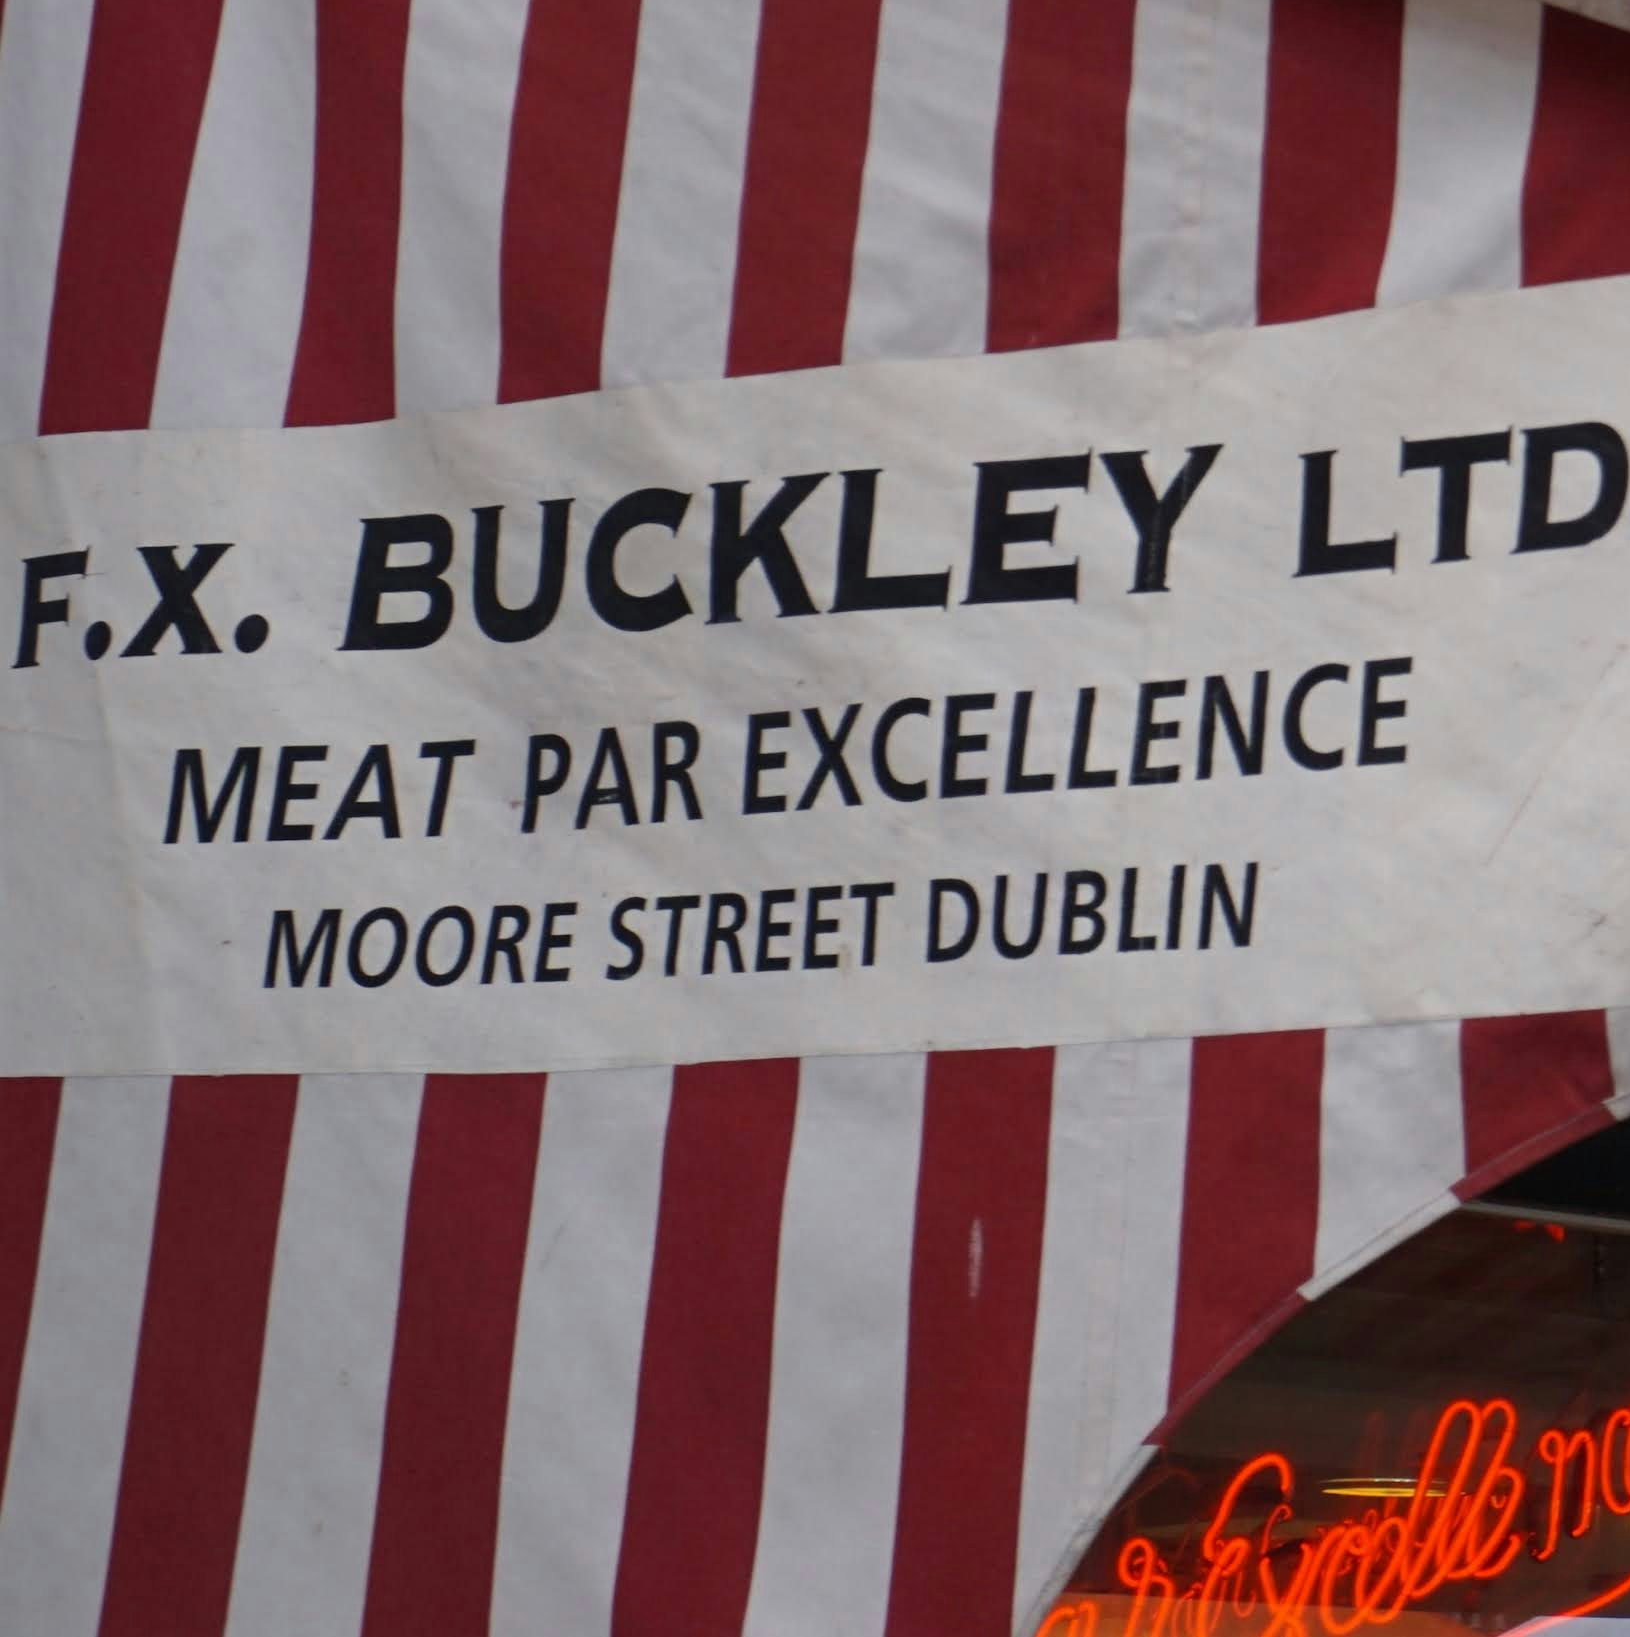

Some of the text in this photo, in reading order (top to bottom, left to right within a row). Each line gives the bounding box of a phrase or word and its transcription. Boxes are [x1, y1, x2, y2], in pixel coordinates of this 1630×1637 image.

[14, 544, 270, 670] F.X.
[336, 441, 1226, 652] BUCKLEY
[163, 655, 1415, 845] MEAT PAR EXCELLENCE
[262, 862, 1261, 989] MOORE STREET DUBLIN
